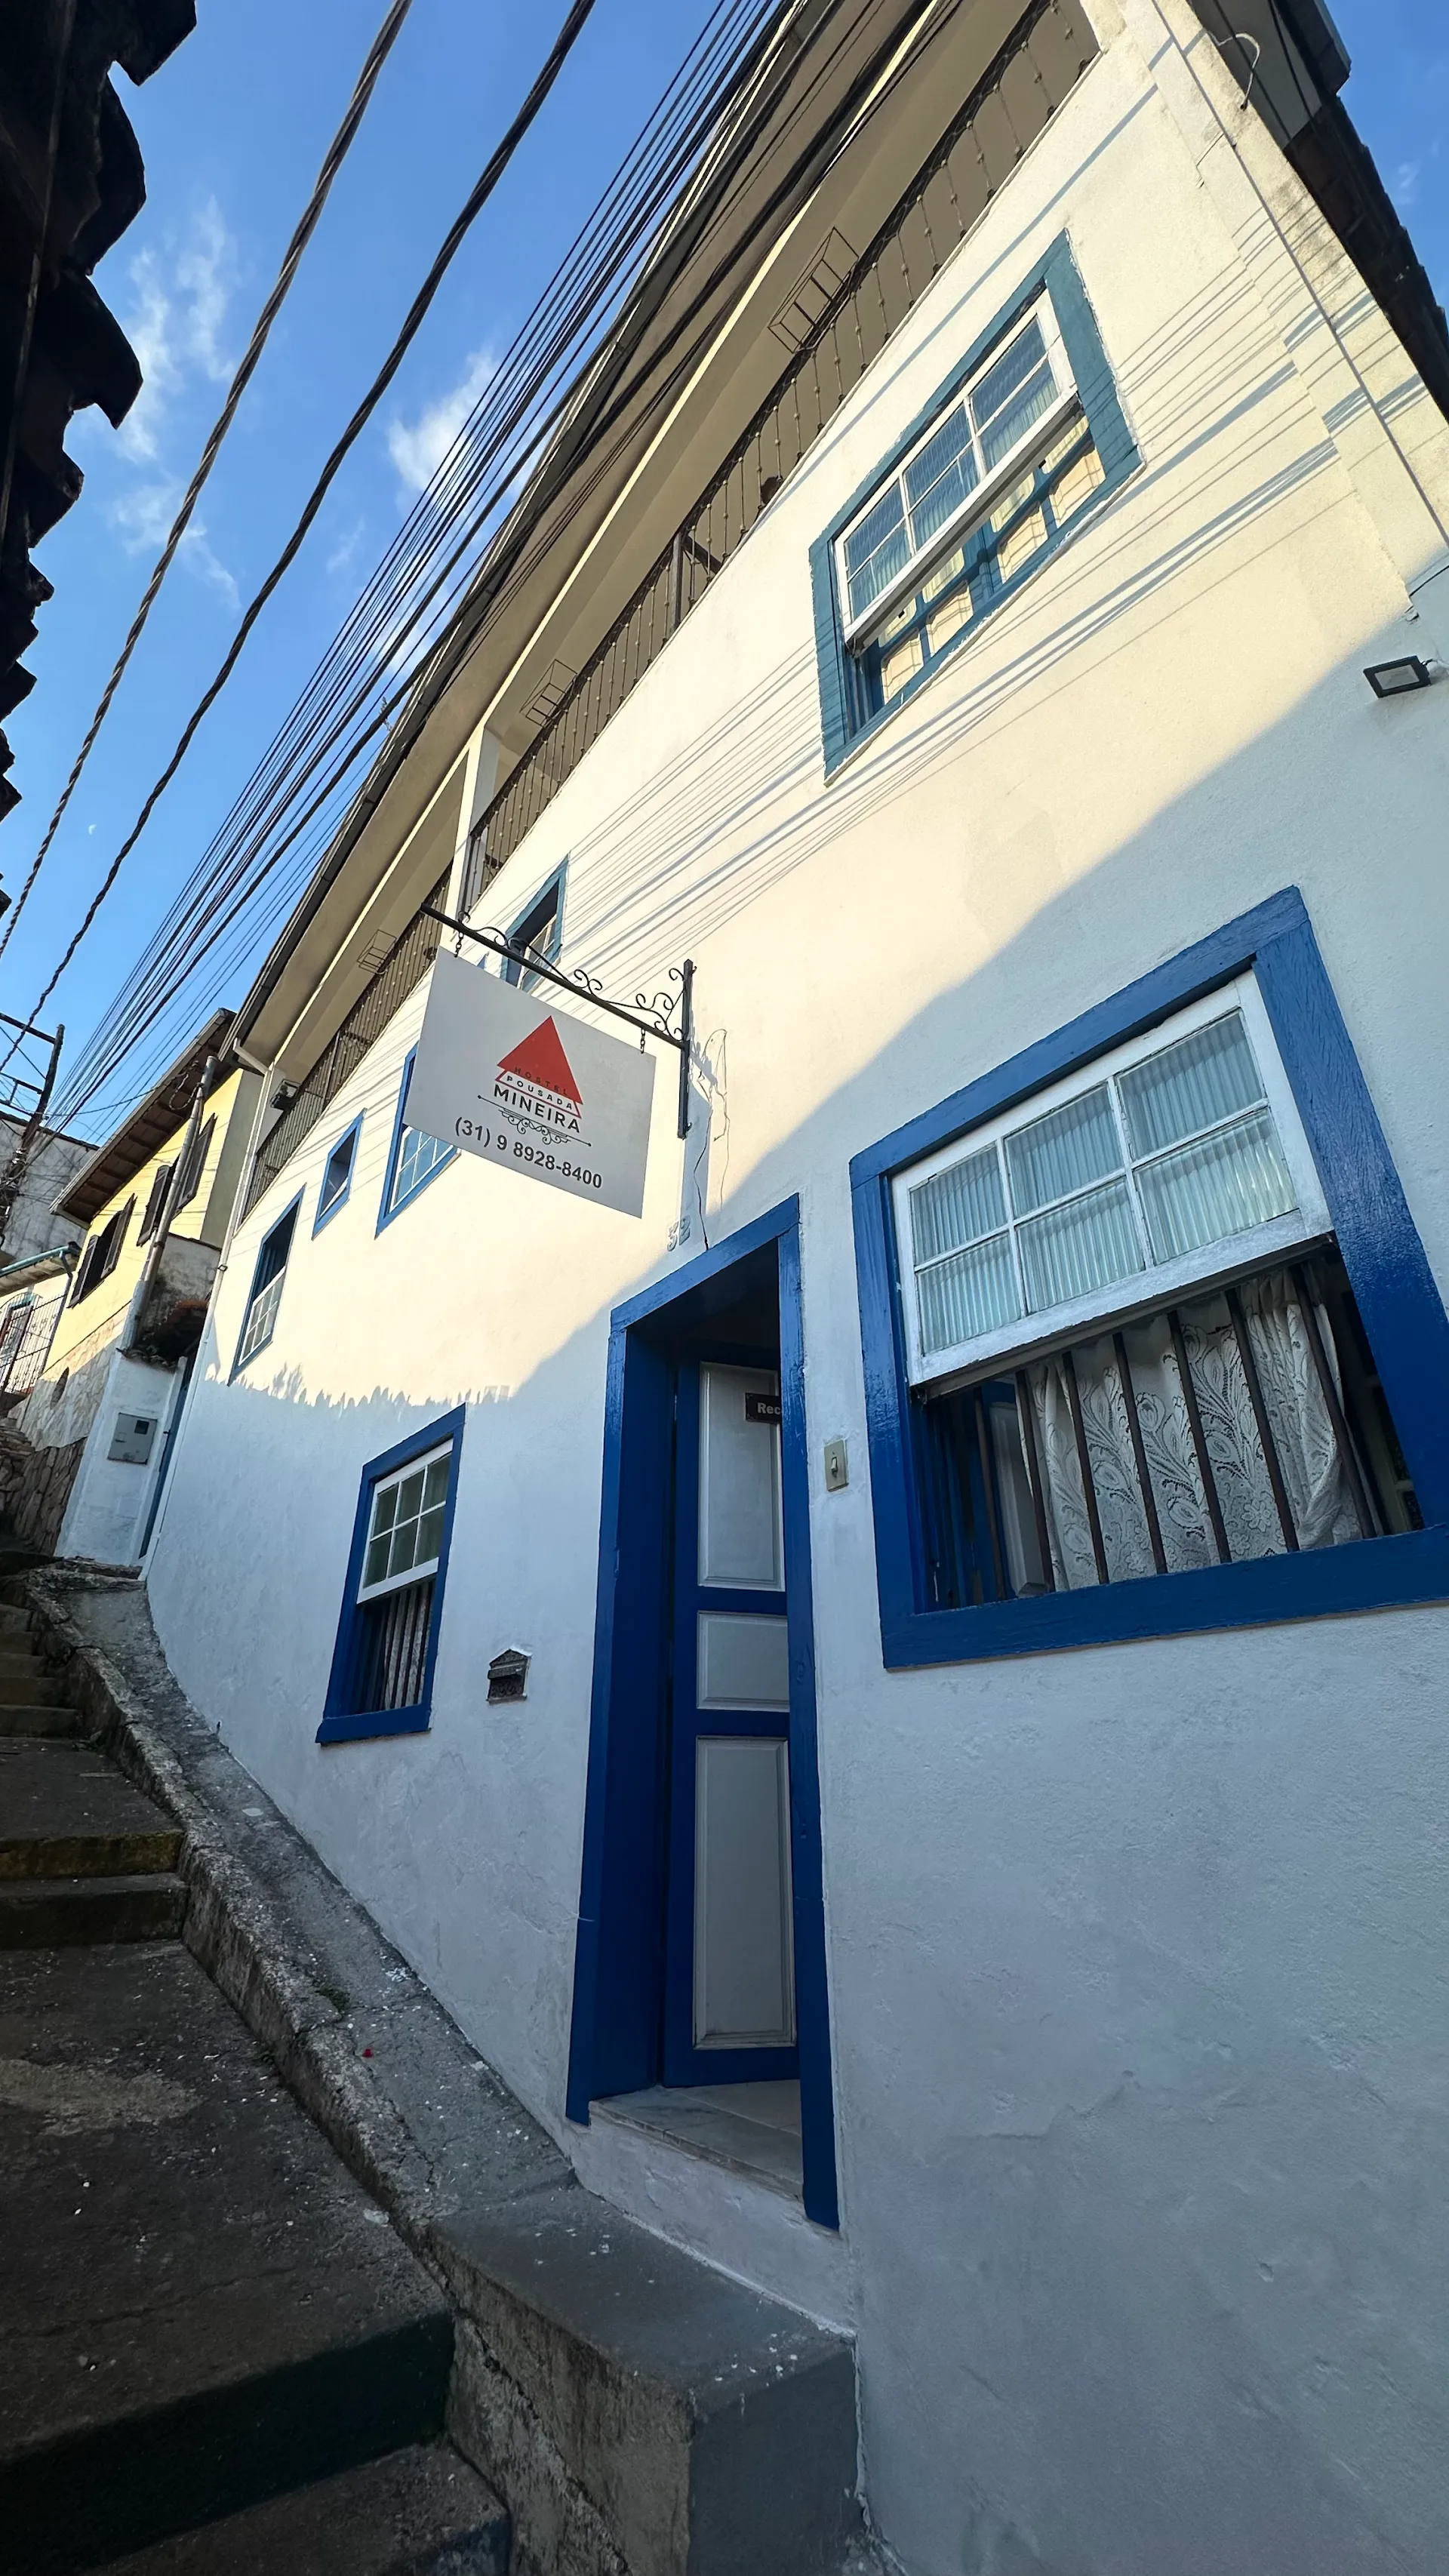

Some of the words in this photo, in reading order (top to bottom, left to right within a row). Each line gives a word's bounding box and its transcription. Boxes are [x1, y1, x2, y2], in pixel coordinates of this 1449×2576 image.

[506, 1075, 573, 1110] POUSADA
[513, 1066, 568, 1096] HOSTEL
[494, 1083, 580, 1134] MINEIRA
[455, 1116, 491, 1148] (31)
[497, 1134, 508, 1151] 9
[512, 1141, 602, 1189] 8928-8400
[757, 1402, 782, 1415] Rec
